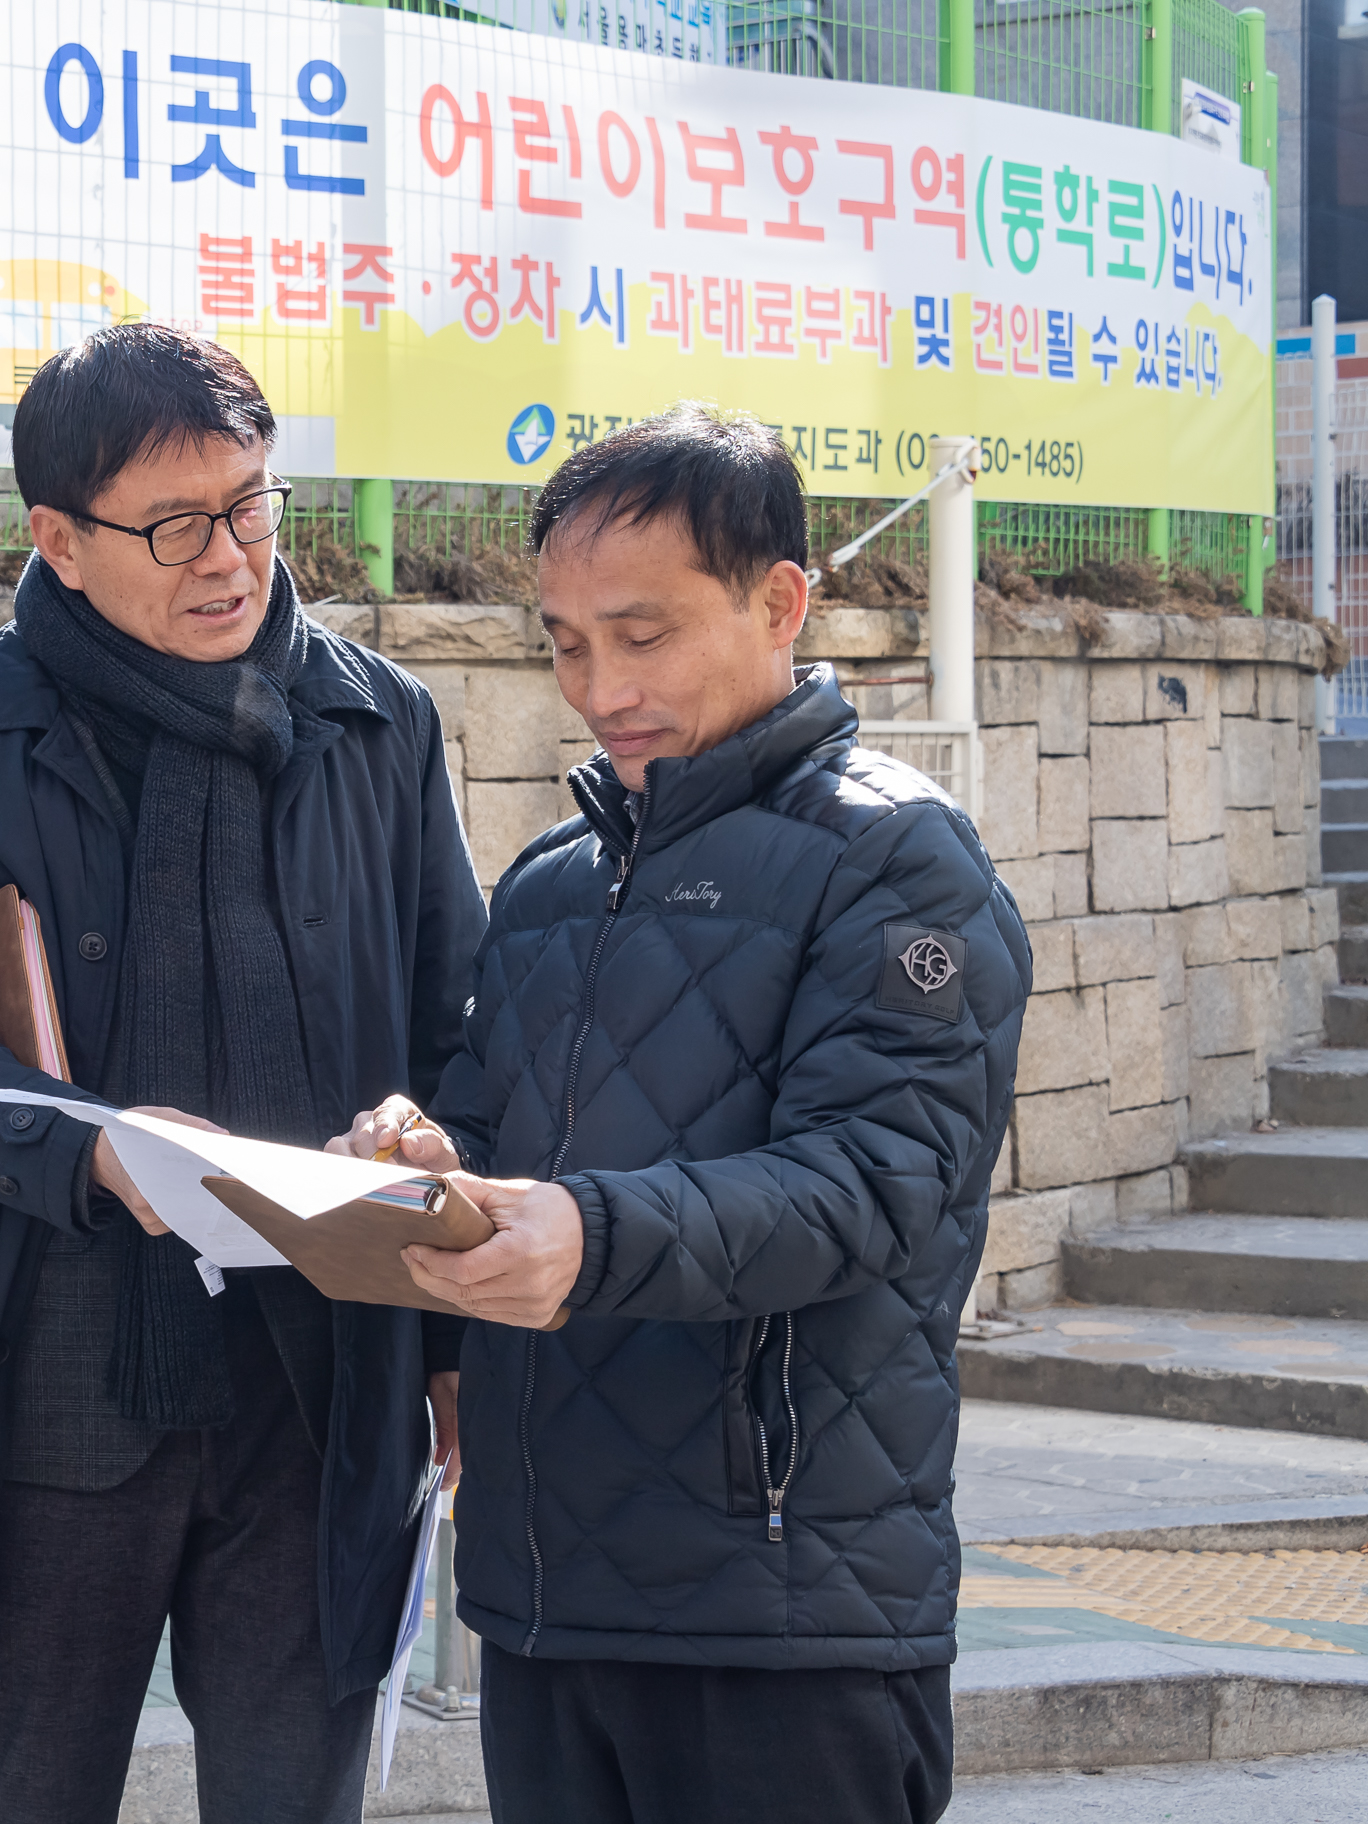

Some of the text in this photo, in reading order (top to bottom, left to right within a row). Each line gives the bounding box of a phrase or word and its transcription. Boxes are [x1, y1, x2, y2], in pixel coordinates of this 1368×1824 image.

[44, 42, 1254, 306] 이곳은 어린이보호구역(통학로)입니다.
[579, 265, 626, 344] 시
[650, 271, 892, 364] 과태료부과
[913, 295, 951, 367] 및
[973, 301, 1075, 380] 견인될
[1091, 315, 1119, 382] 수
[1134, 318, 1224, 397] 있습니다.
[774, 424, 883, 475] 지도과
